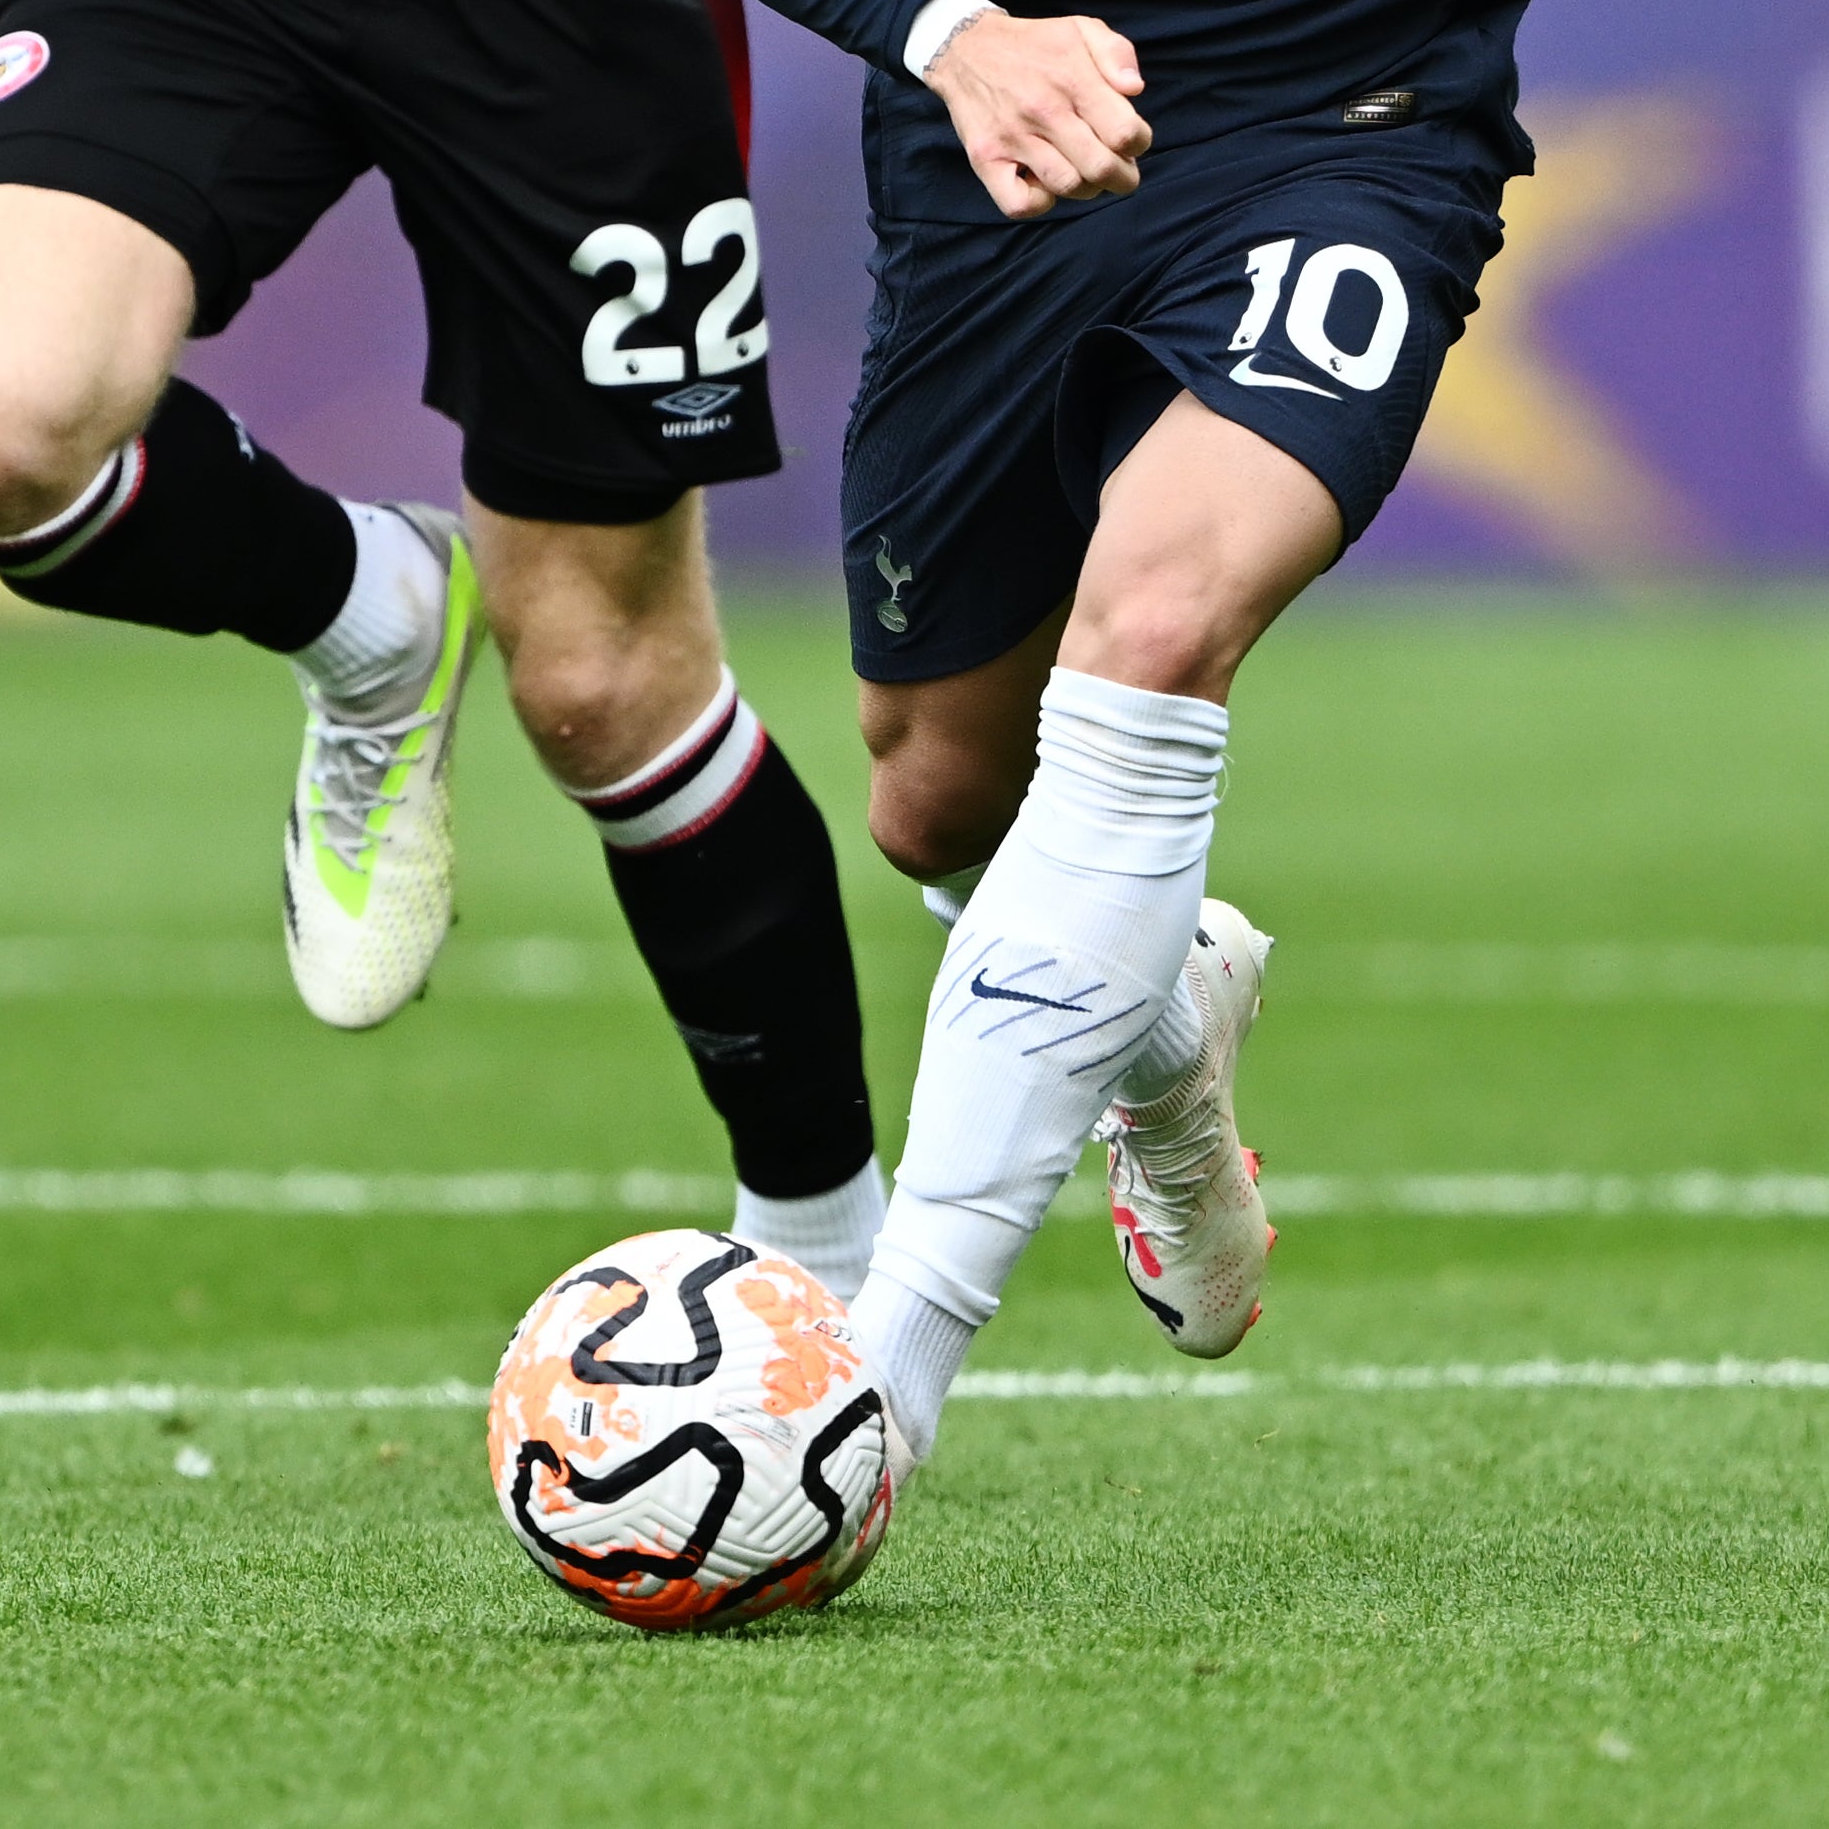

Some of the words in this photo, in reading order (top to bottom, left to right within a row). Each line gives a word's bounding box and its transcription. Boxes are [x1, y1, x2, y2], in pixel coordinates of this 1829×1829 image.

[568, 196, 770, 388] 22
[1226, 237, 1410, 392] 10
[661, 411, 733, 439] umbro
